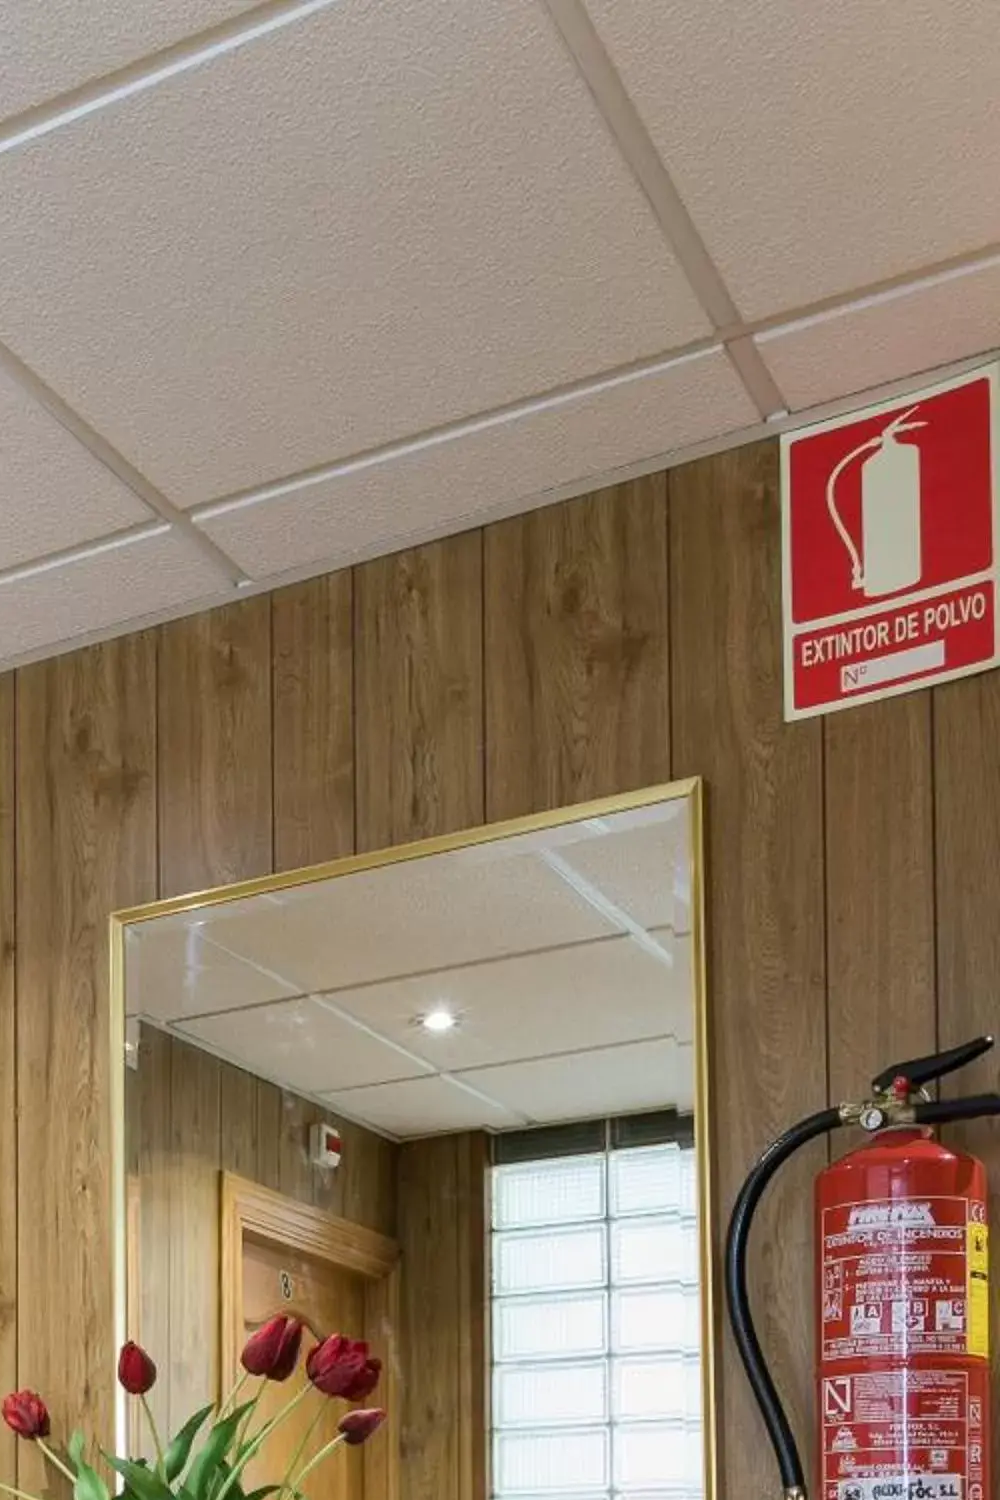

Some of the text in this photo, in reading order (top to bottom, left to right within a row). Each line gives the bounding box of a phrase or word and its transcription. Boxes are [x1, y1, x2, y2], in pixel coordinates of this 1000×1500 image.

[802, 592, 986, 667] EXTINTOR DE POLVO
[866, 1304, 879, 1317] A
[913, 1302, 924, 1314] B
[953, 1301, 964, 1315] C
